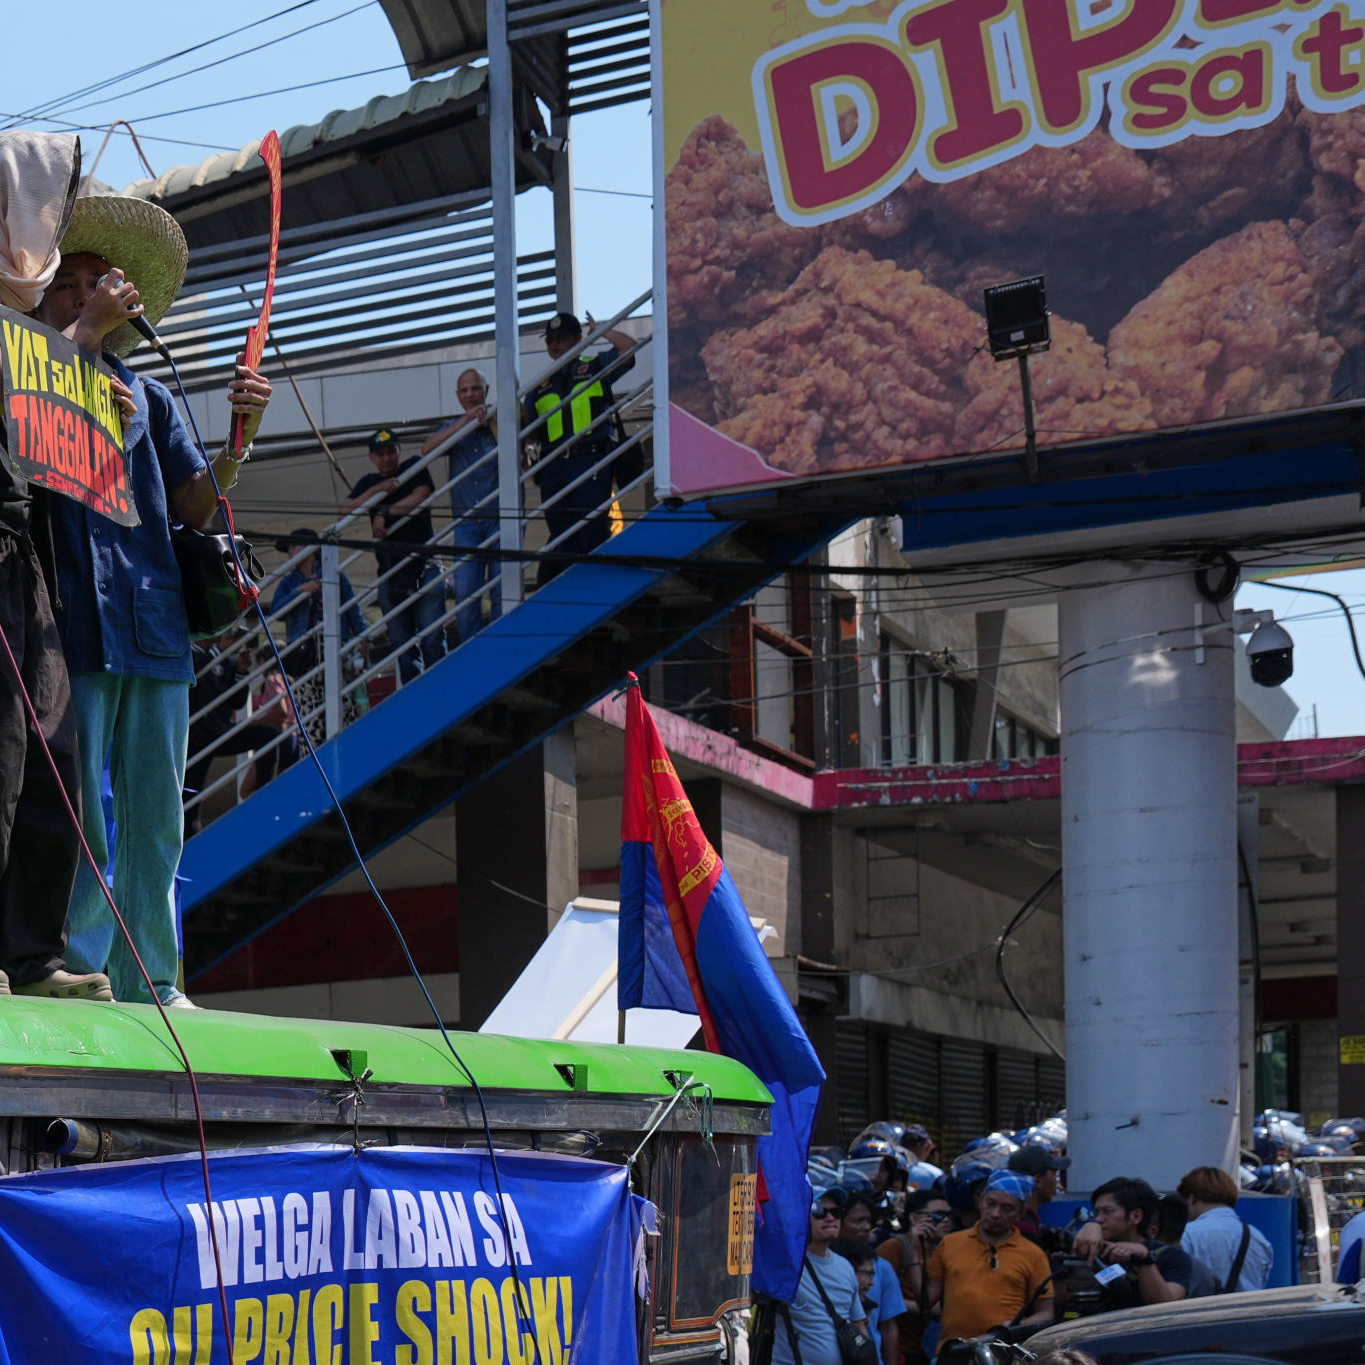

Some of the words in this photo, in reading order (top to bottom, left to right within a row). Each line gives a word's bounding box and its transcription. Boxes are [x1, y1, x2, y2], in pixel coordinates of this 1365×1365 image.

[1129, 48, 1264, 130] sa
[2, 319, 49, 392] VAT
[186, 1195, 333, 1289] WELGA
[340, 1187, 477, 1271] LABAN
[481, 1192, 534, 1268] SA
